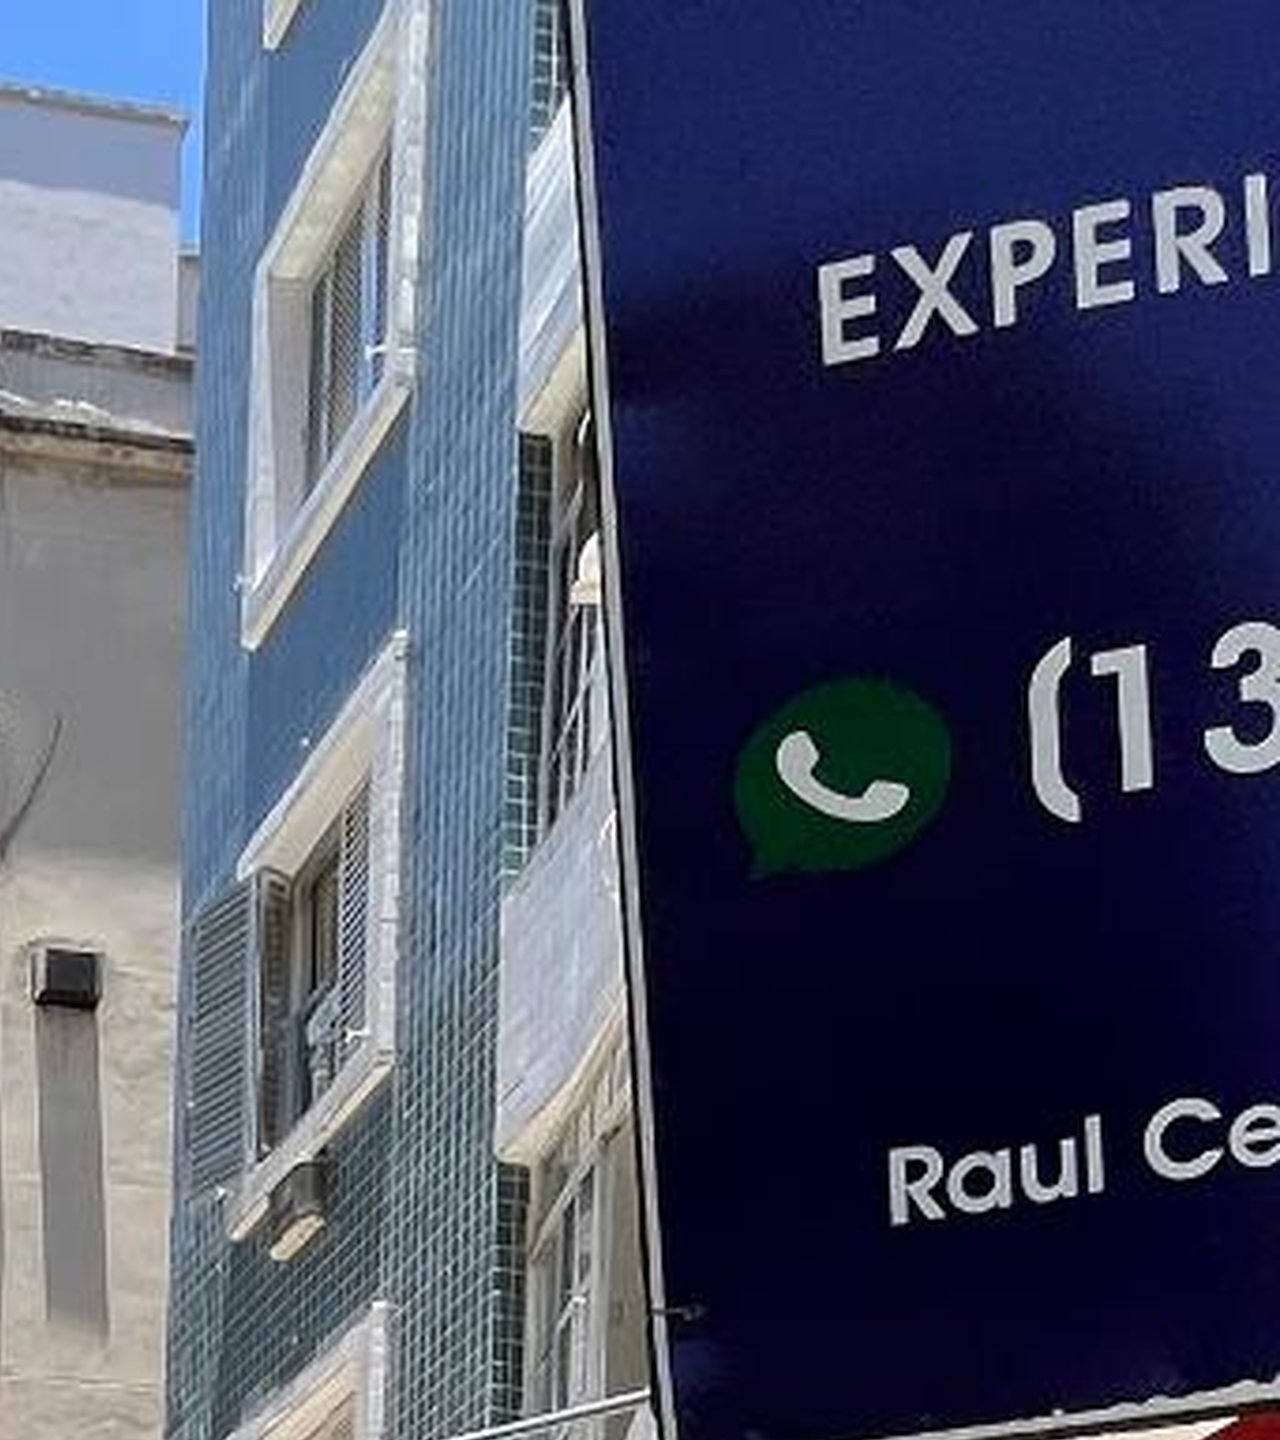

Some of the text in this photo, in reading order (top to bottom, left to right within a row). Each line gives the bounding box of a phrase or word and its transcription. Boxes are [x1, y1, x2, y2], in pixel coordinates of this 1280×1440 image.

[816, 172, 1271, 366] EXPERI
[1028, 622, 1280, 823] (13
[888, 1097, 1280, 1226] Raul Ce
